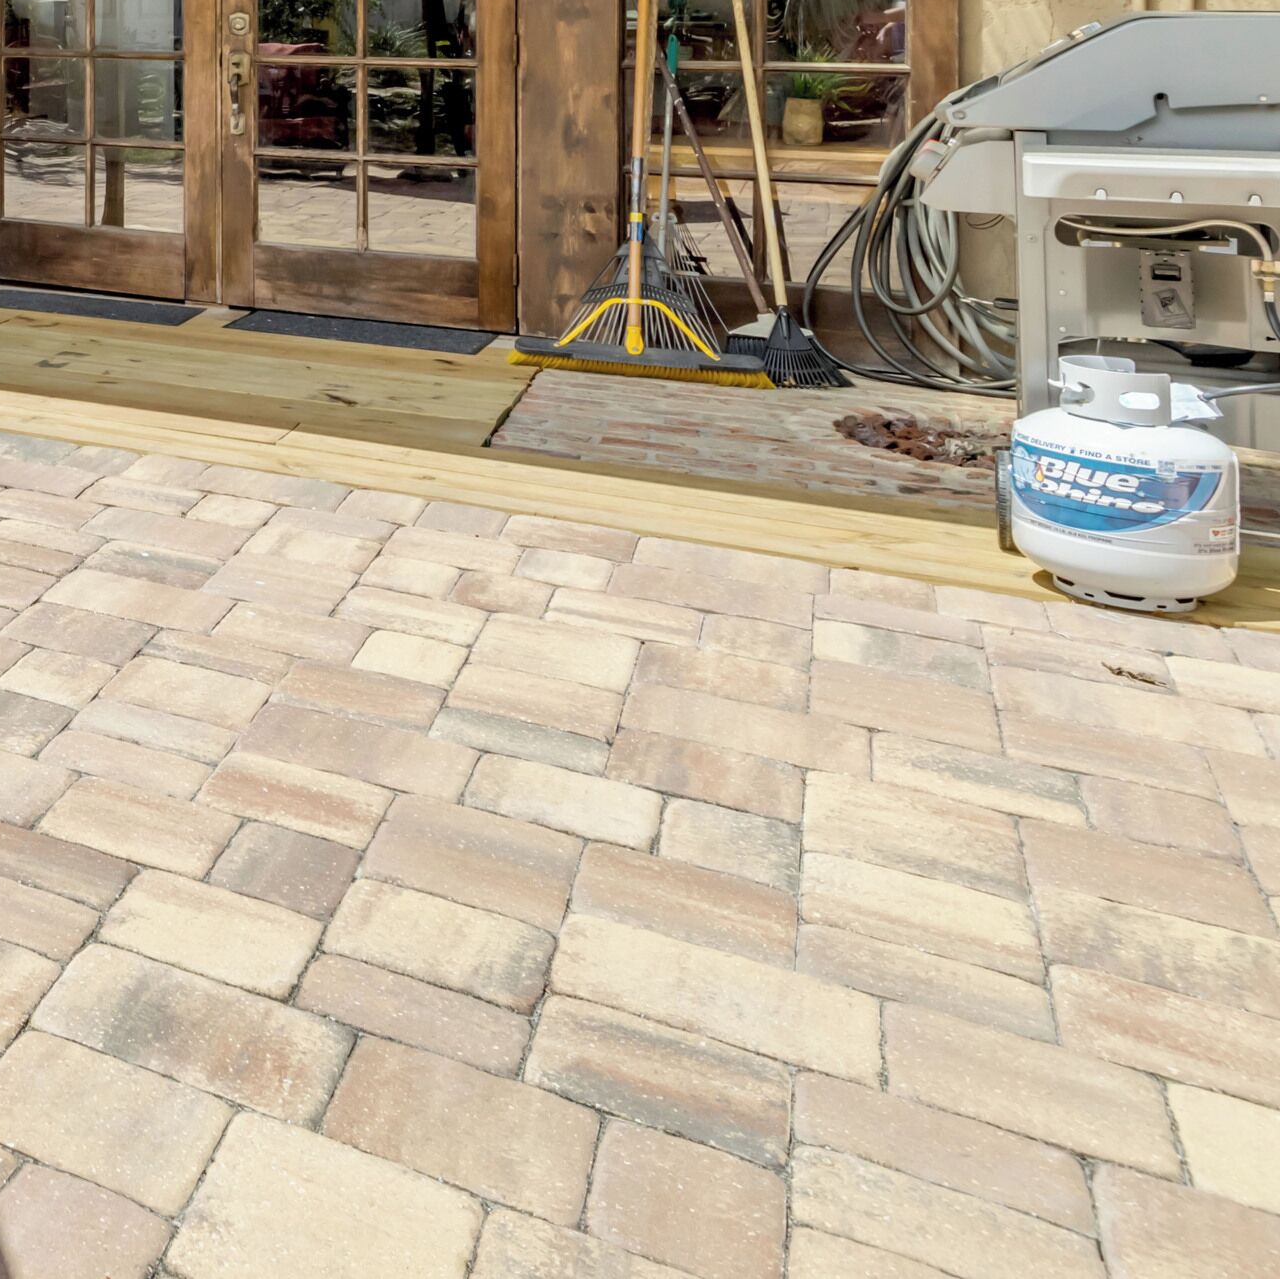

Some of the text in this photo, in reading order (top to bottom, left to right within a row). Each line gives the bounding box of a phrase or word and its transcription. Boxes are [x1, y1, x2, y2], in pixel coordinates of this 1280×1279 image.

[1030, 436, 1066, 451] DELIVERY
[1079, 449, 1103, 459] FIND
[1115, 454, 1152, 466] STORE
[1039, 455, 1140, 493] Blue
[1034, 478, 1164, 514] Rhino
